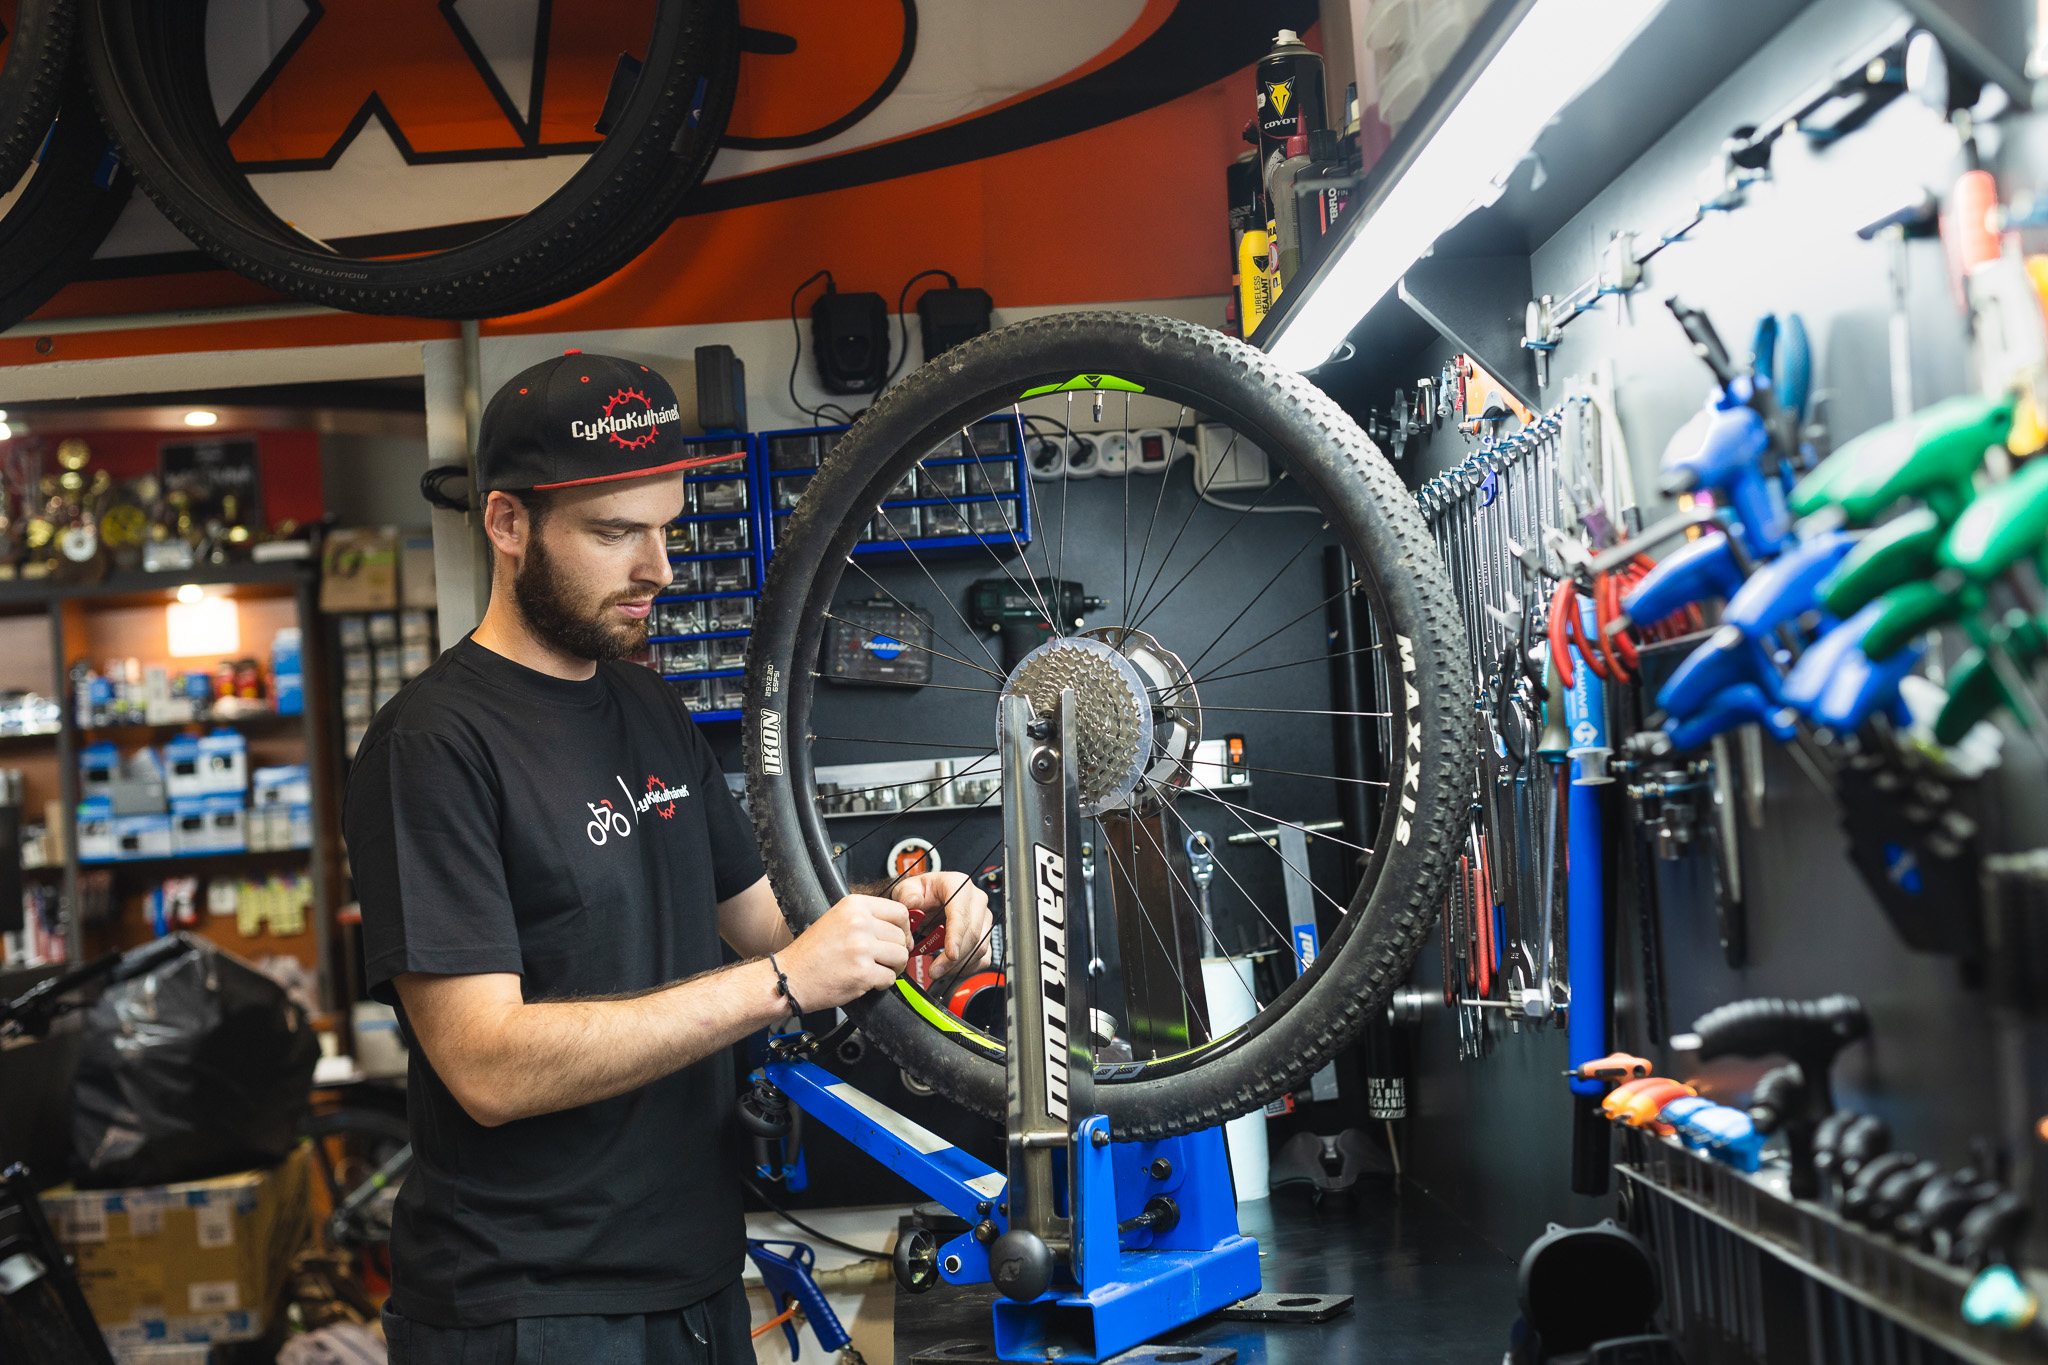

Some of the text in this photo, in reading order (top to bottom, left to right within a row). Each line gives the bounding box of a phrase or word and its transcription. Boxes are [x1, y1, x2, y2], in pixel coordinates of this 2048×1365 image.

[1264, 117, 1298, 130] COYOT
[1253, 275, 1261, 316] TUBELESS
[761, 708, 783, 775] IKON
[1396, 633, 1422, 847] MAXXIS
[919, 944, 928, 954] DT
